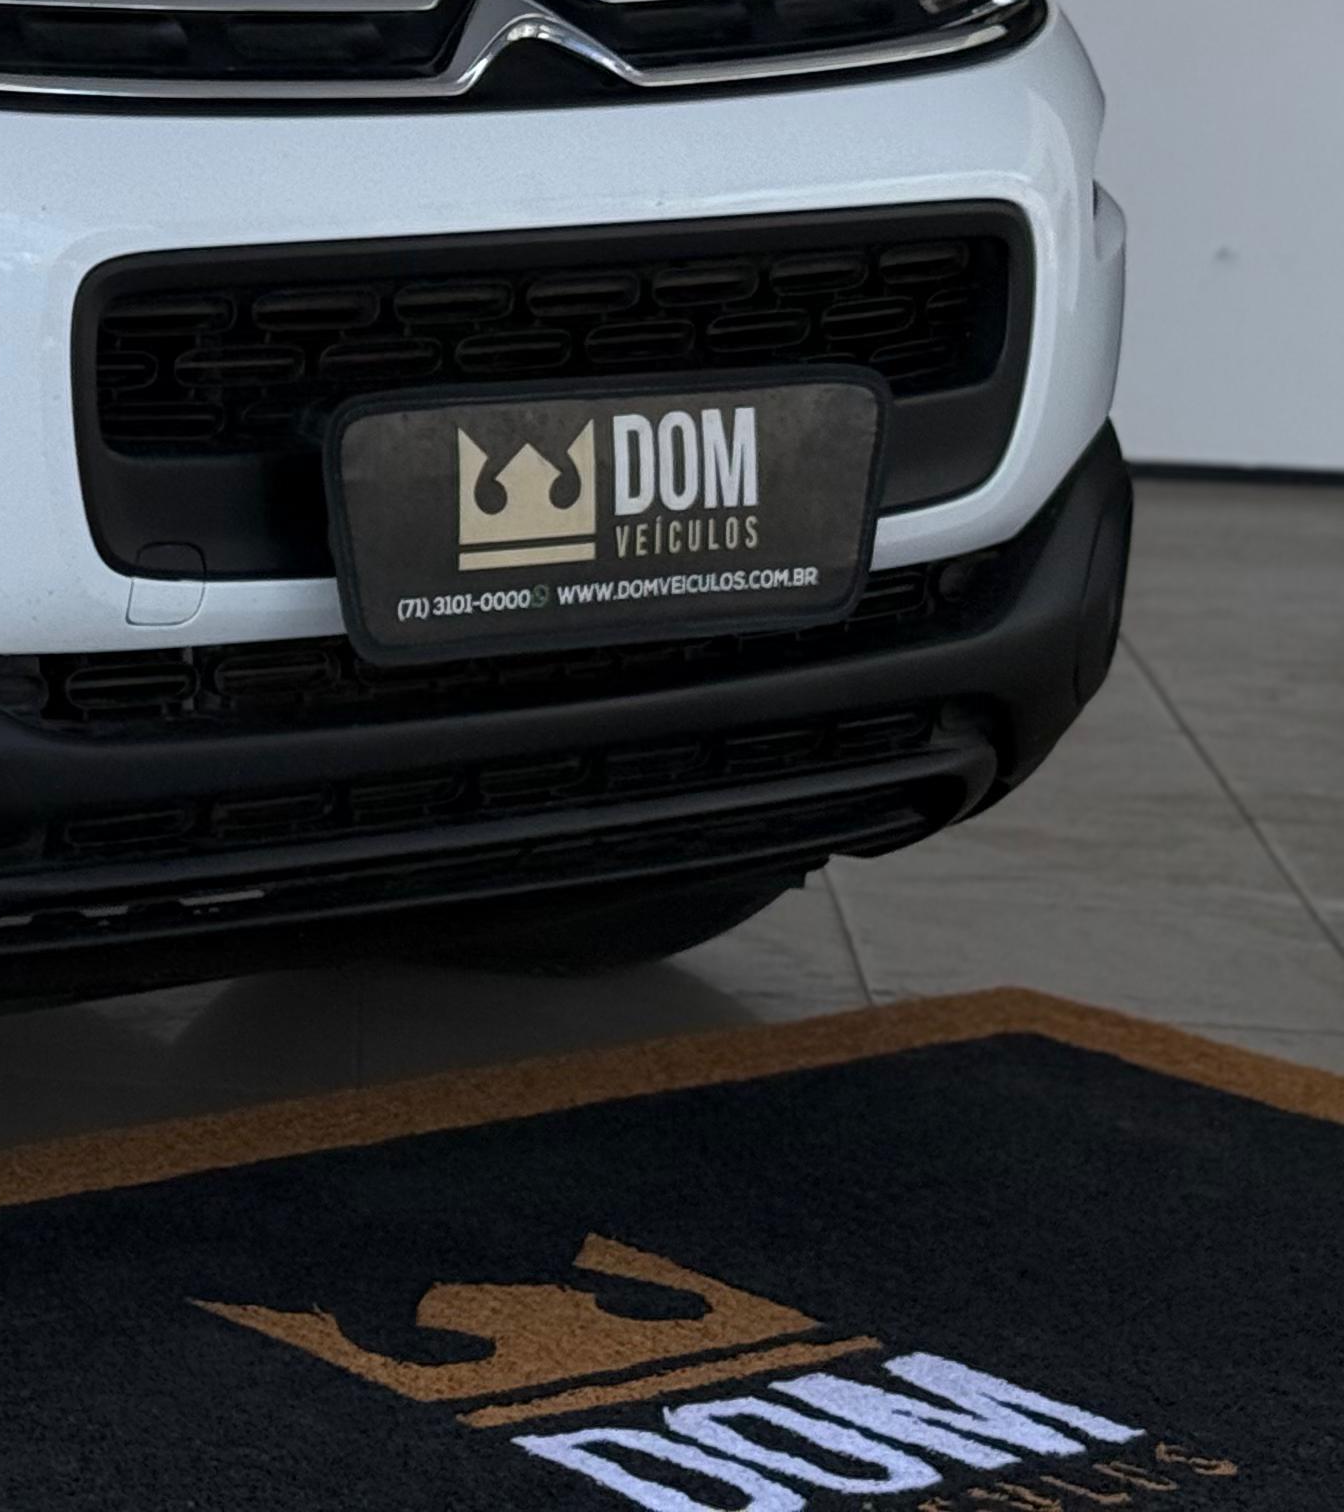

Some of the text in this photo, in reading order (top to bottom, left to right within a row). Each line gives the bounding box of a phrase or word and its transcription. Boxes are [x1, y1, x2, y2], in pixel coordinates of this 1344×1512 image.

[613, 408, 759, 516] DOM
[616, 516, 759, 558] VEÍCULOS
[397, 567, 820, 623] (71) 3101-0000 WWW.DOMVEICULOS.COM.BR
[512, 1352, 1146, 1512] DOM
